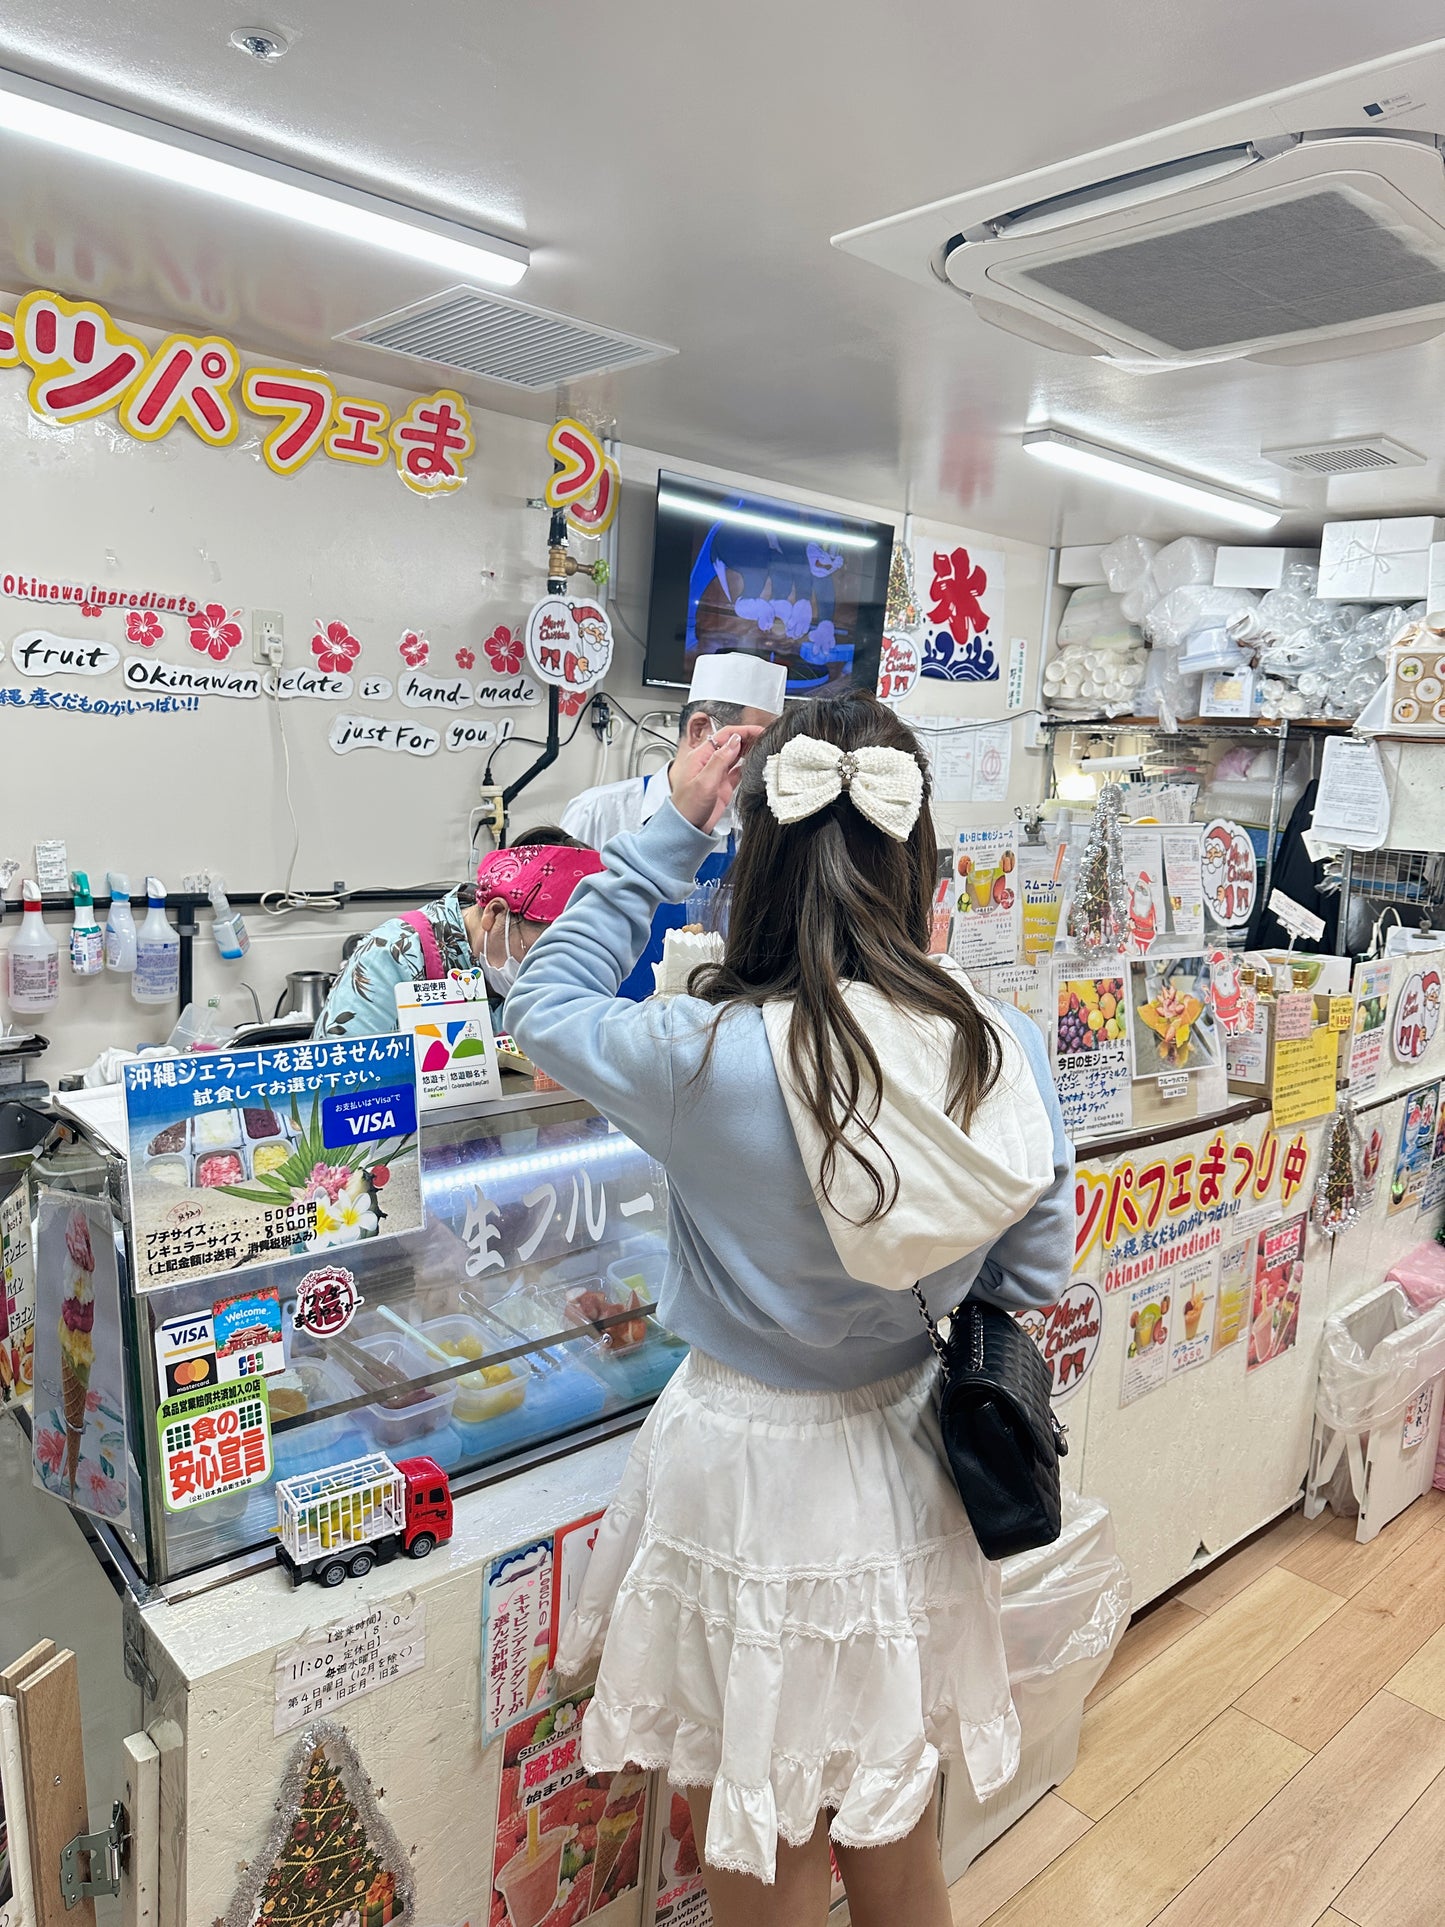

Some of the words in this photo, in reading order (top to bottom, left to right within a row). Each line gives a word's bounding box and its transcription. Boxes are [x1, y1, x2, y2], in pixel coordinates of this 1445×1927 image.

[0, 300, 468, 480] ツパフェま
[3, 574, 85, 602] Okinawa
[90, 586, 197, 614] ingredients
[926, 547, 989, 645] 氷
[20, 638, 110, 669] fruit
[127, 662, 259, 693] Okinawan
[363, 681, 381, 697] is
[479, 679, 535, 701] made
[337, 721, 393, 746] just
[395, 726, 436, 751] For
[1024, 880, 1062, 891] スムージー
[413, 981, 447, 993] 歡迎使用
[415, 992, 448, 1003] ようこそ
[128, 1038, 411, 1092] 沖縄ジェラートを送りませんか!
[1057, 1050, 1125, 1071] 今日の生ジュース
[192, 1068, 383, 1108] 試食してお選び下さい。
[423, 1084, 448, 1093] EasyCard
[345, 1111, 396, 1136] VISA
[1105, 1255, 1155, 1293] Okinawa
[1158, 1226, 1222, 1269] ingredients
[225, 1307, 267, 1324] Welcome
[169, 1324, 209, 1346] VISA
[239, 1352, 264, 1377] JCB
[176, 1379, 210, 1393] mastercard
[191, 1410, 239, 1445] 食の
[168, 1426, 266, 1501] 安心宣言
[292, 1653, 334, 1680] 11:00
[325, 1648, 380, 1679] 毎週水曜日
